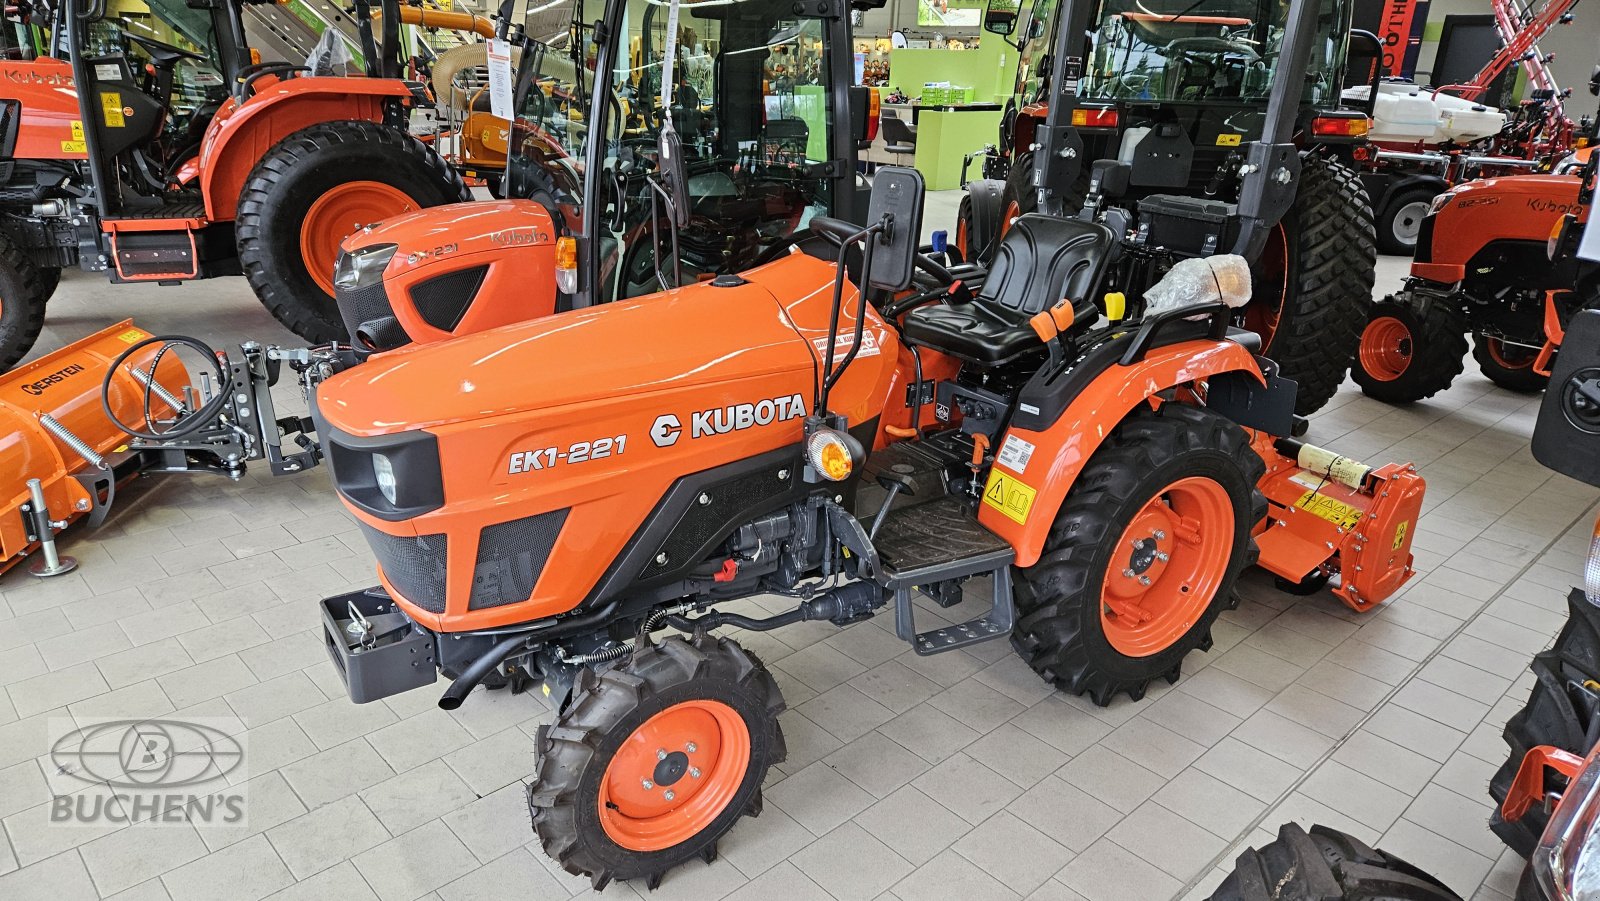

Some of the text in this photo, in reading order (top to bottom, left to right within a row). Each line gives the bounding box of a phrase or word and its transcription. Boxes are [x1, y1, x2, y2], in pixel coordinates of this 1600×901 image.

[3, 69, 76, 86] Kubota
[1526, 197, 1584, 215] Kubota
[489, 229, 549, 246] Kubota
[690, 393, 808, 438] KUBOTA
[508, 433, 628, 475] EK1-221
